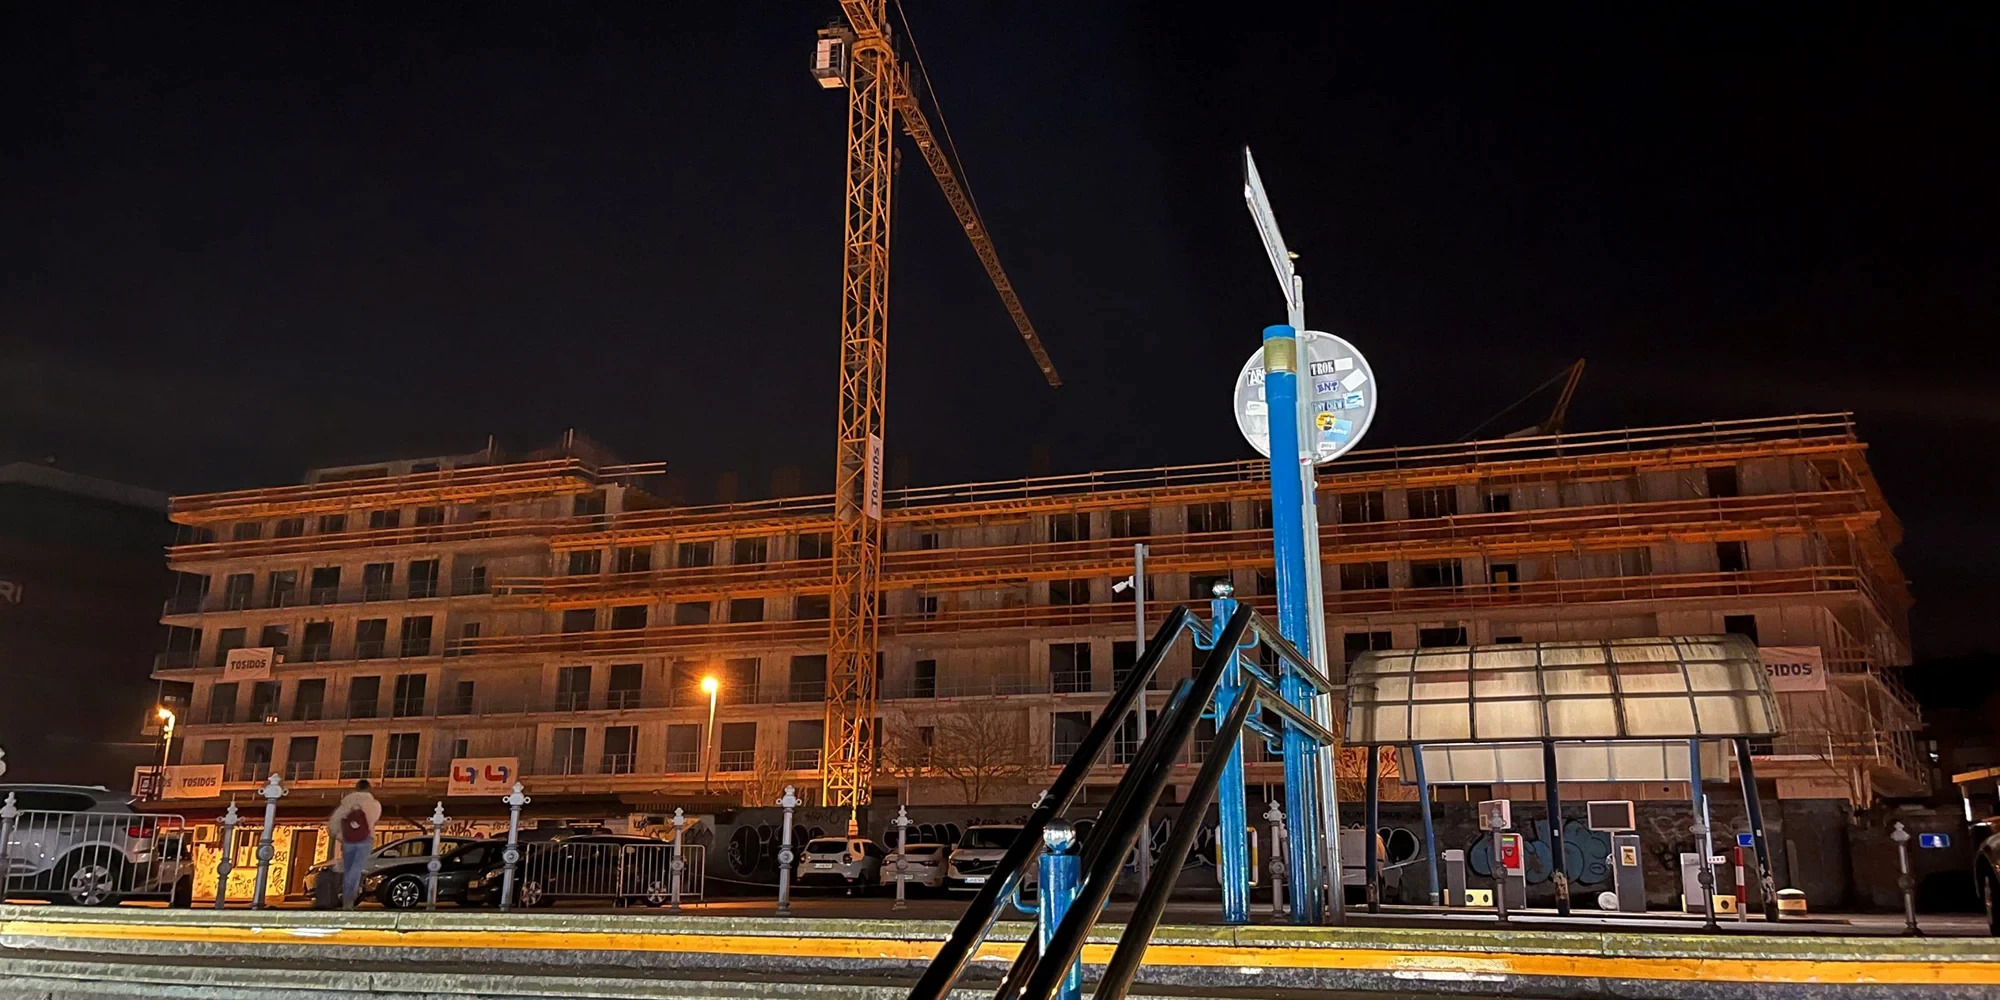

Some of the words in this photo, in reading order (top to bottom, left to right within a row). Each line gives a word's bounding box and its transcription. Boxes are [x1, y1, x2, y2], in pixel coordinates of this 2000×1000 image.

[1310, 360, 1334, 376] TROK
[871, 446, 880, 508] TOSIDOS
[231, 659, 267, 670] TOSIDOS
[182, 777, 217, 788] TOSIDOS
